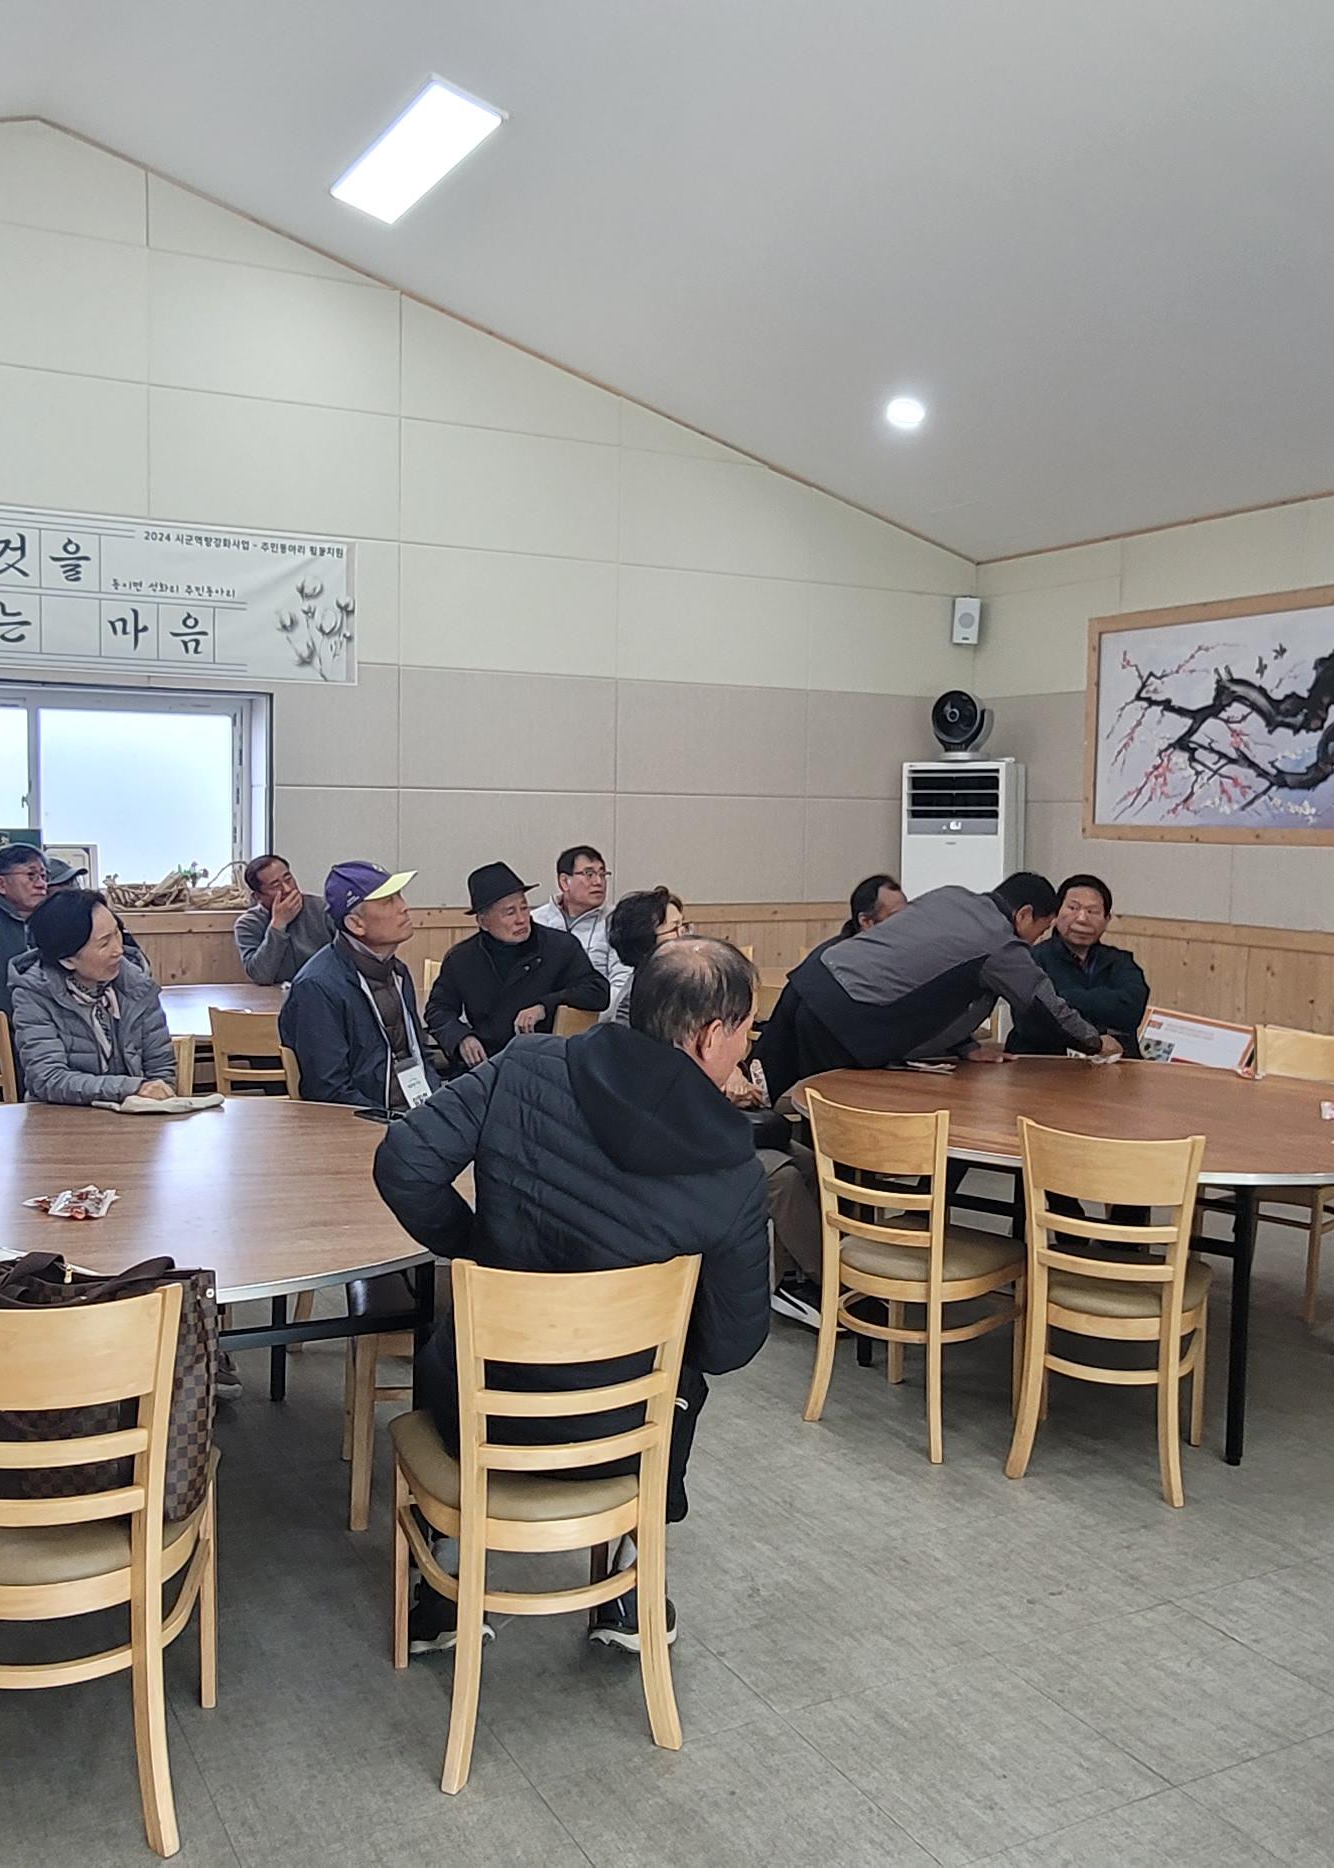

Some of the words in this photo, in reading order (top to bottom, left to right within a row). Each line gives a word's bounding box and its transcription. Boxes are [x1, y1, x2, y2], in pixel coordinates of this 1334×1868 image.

[143, 530, 172, 543] 2024
[175, 532, 251, 551] 시군역량강화사업
[260, 541, 306, 556] 주민동아리
[111, 577, 144, 593] 동이면
[185, 584, 237, 599] 주민동아리
[107, 607, 210, 655] 마음
